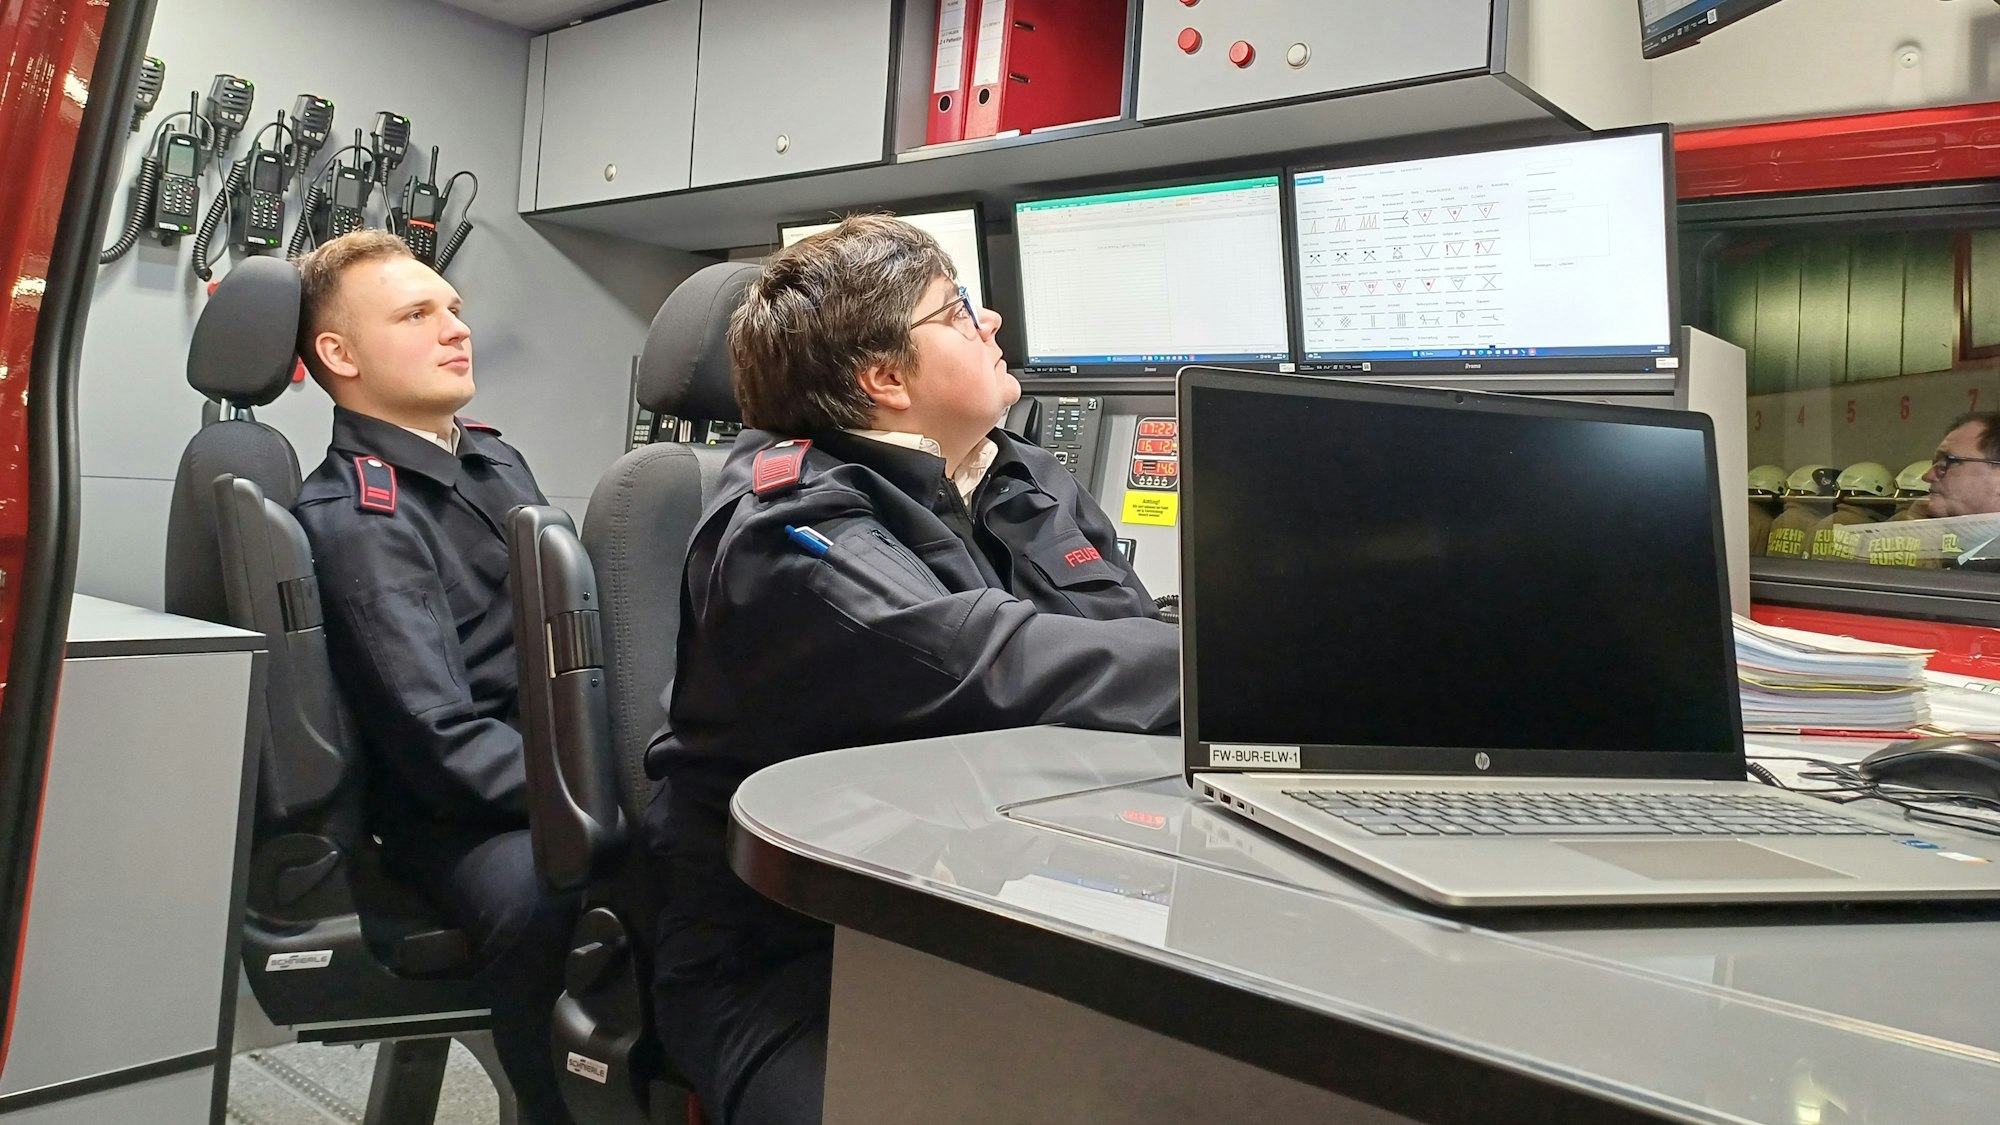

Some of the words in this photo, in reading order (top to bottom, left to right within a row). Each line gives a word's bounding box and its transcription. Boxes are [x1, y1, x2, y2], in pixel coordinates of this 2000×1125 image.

[1088, 401, 1097, 409] 21
[1900, 395, 1910, 420] 6
[1968, 388, 1978, 412] 7
[1754, 410, 1762, 431] 3
[1797, 406, 1805, 427] 4
[1847, 400, 1856, 424] 5
[1144, 422, 1173, 435] 17:22
[1213, 750, 1298, 763] FW-BUR-ELW-1
[1475, 752, 1490, 770] hp
